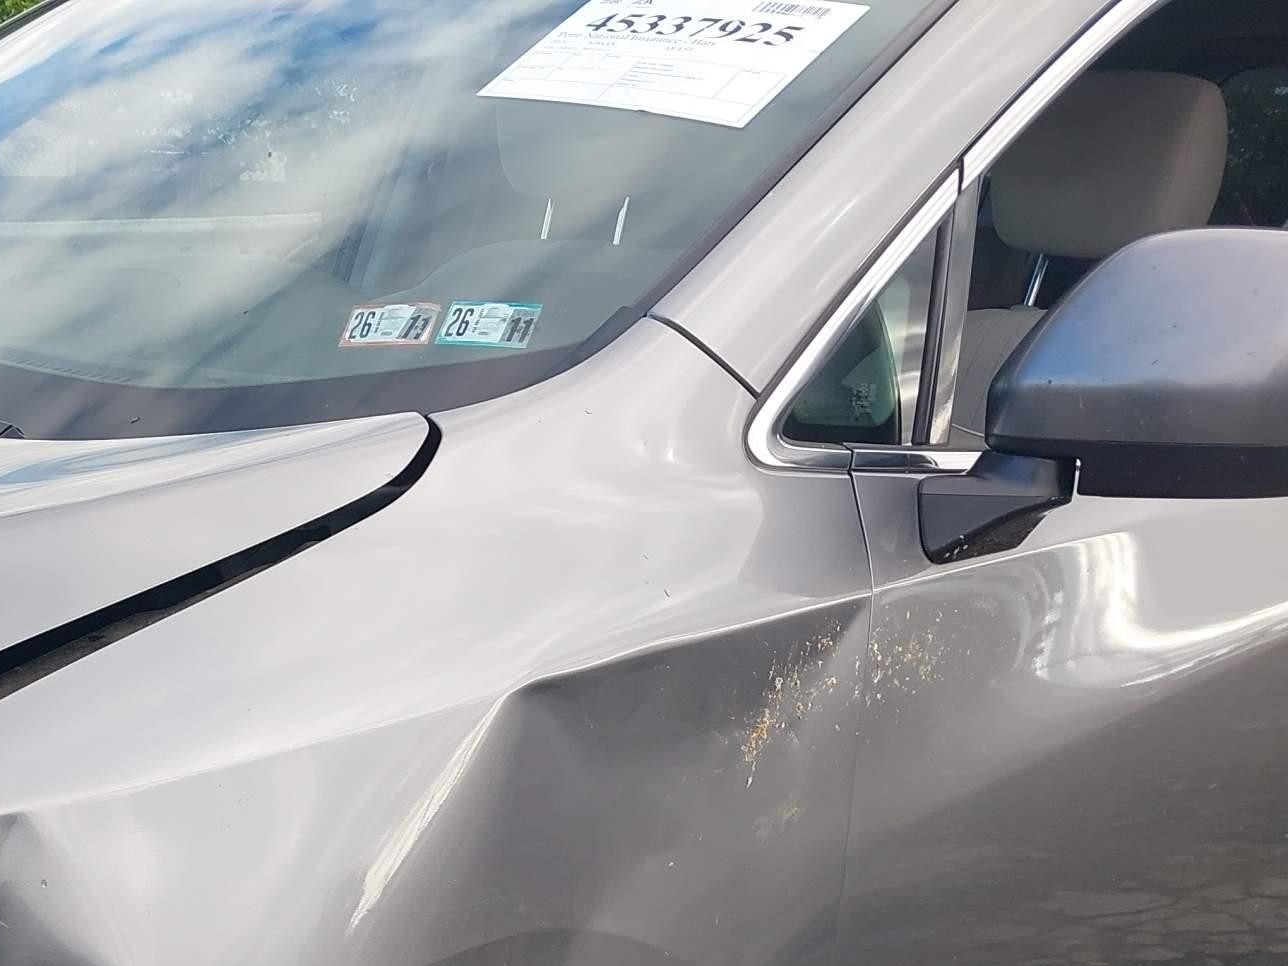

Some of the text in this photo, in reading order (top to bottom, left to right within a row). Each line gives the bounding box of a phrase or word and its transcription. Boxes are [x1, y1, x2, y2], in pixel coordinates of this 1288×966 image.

[583, 12, 806, 47] 45337925
[348, 311, 376, 340] 26
[444, 307, 475, 337] 26
[505, 316, 535, 343] 11
